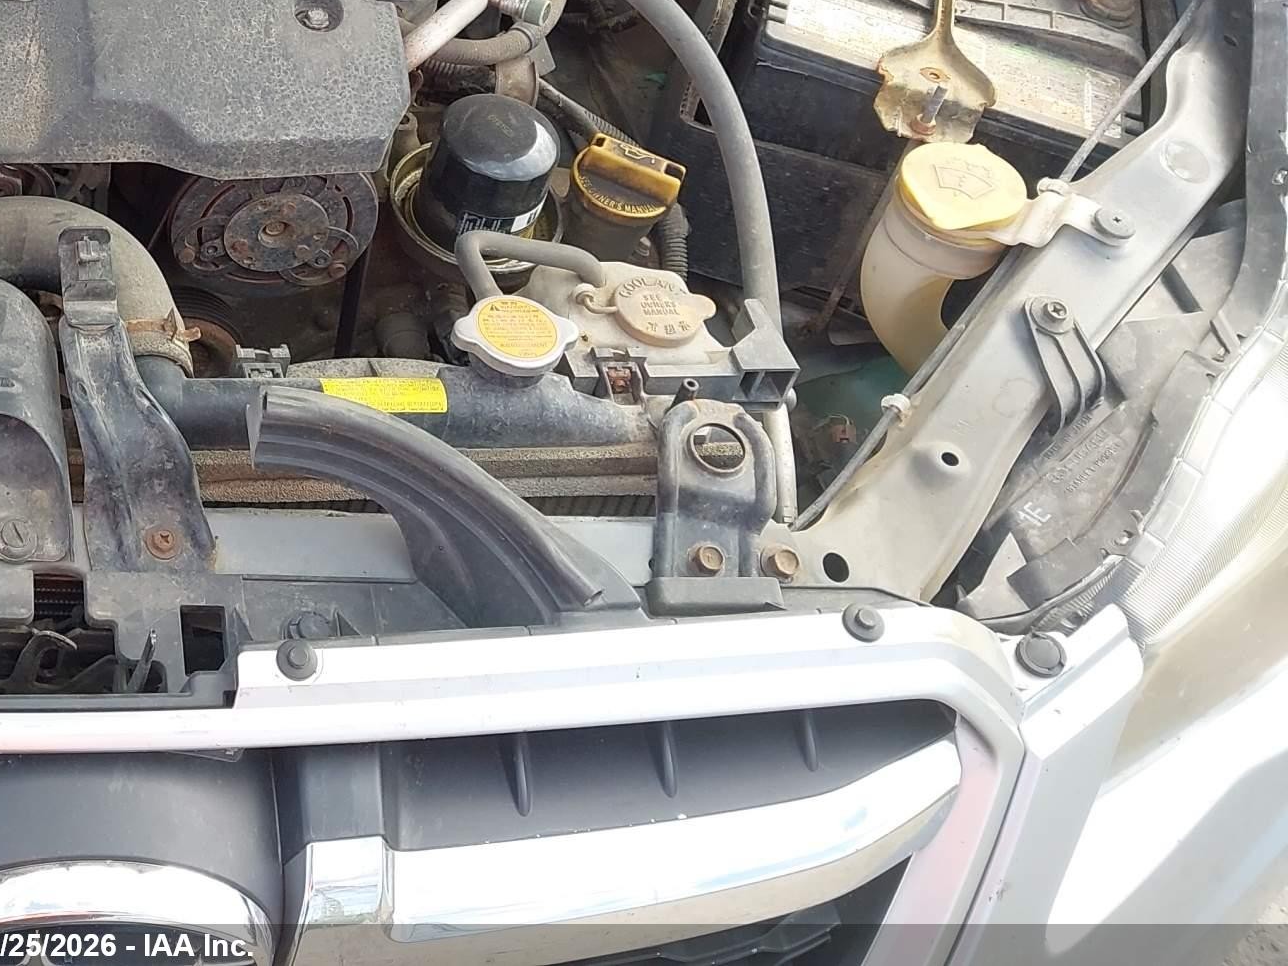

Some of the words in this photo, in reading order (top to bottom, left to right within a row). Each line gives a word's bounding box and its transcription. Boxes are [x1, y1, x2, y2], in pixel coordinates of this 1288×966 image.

[578, 175, 592, 188] SEE
[589, 188, 622, 211] OWNER'S
[624, 203, 659, 215] MANUAL
[1017, 501, 1052, 527] 1E
